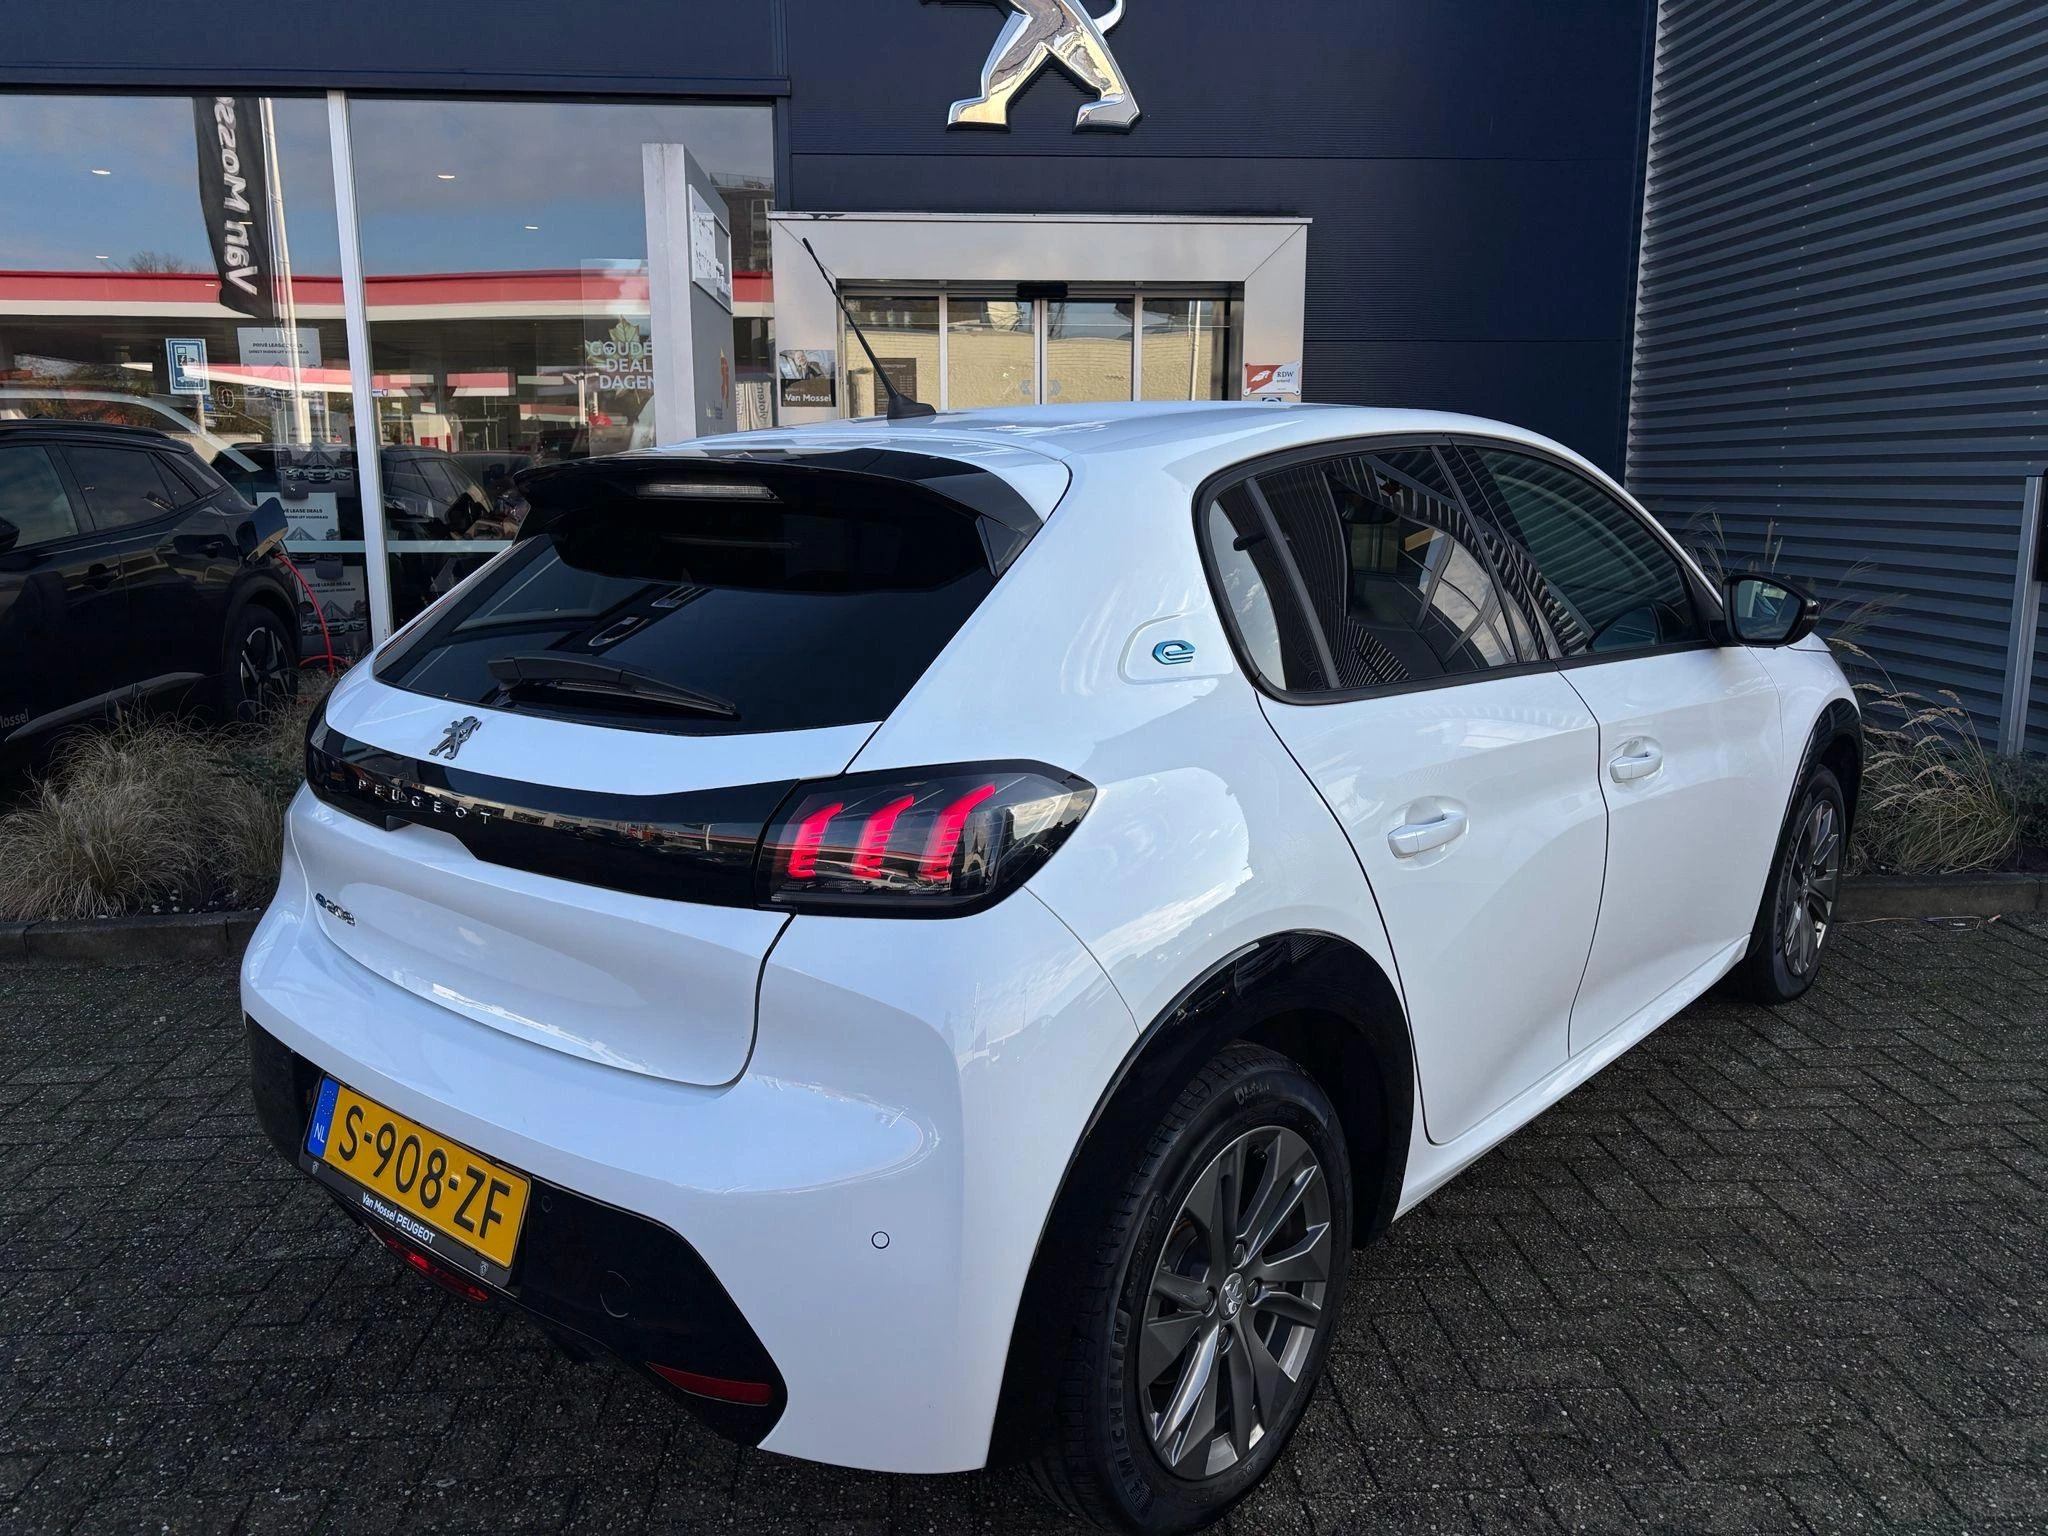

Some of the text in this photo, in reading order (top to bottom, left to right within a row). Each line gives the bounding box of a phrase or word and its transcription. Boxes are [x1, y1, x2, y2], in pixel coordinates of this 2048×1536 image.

[785, 394, 832, 402] Van Mossel
[358, 778, 492, 825] PEUGEOT
[314, 1122, 325, 1144] NL
[338, 1104, 512, 1240] S-908-ZF
[362, 1191, 436, 1244] Van Mossel PEUGEOT
